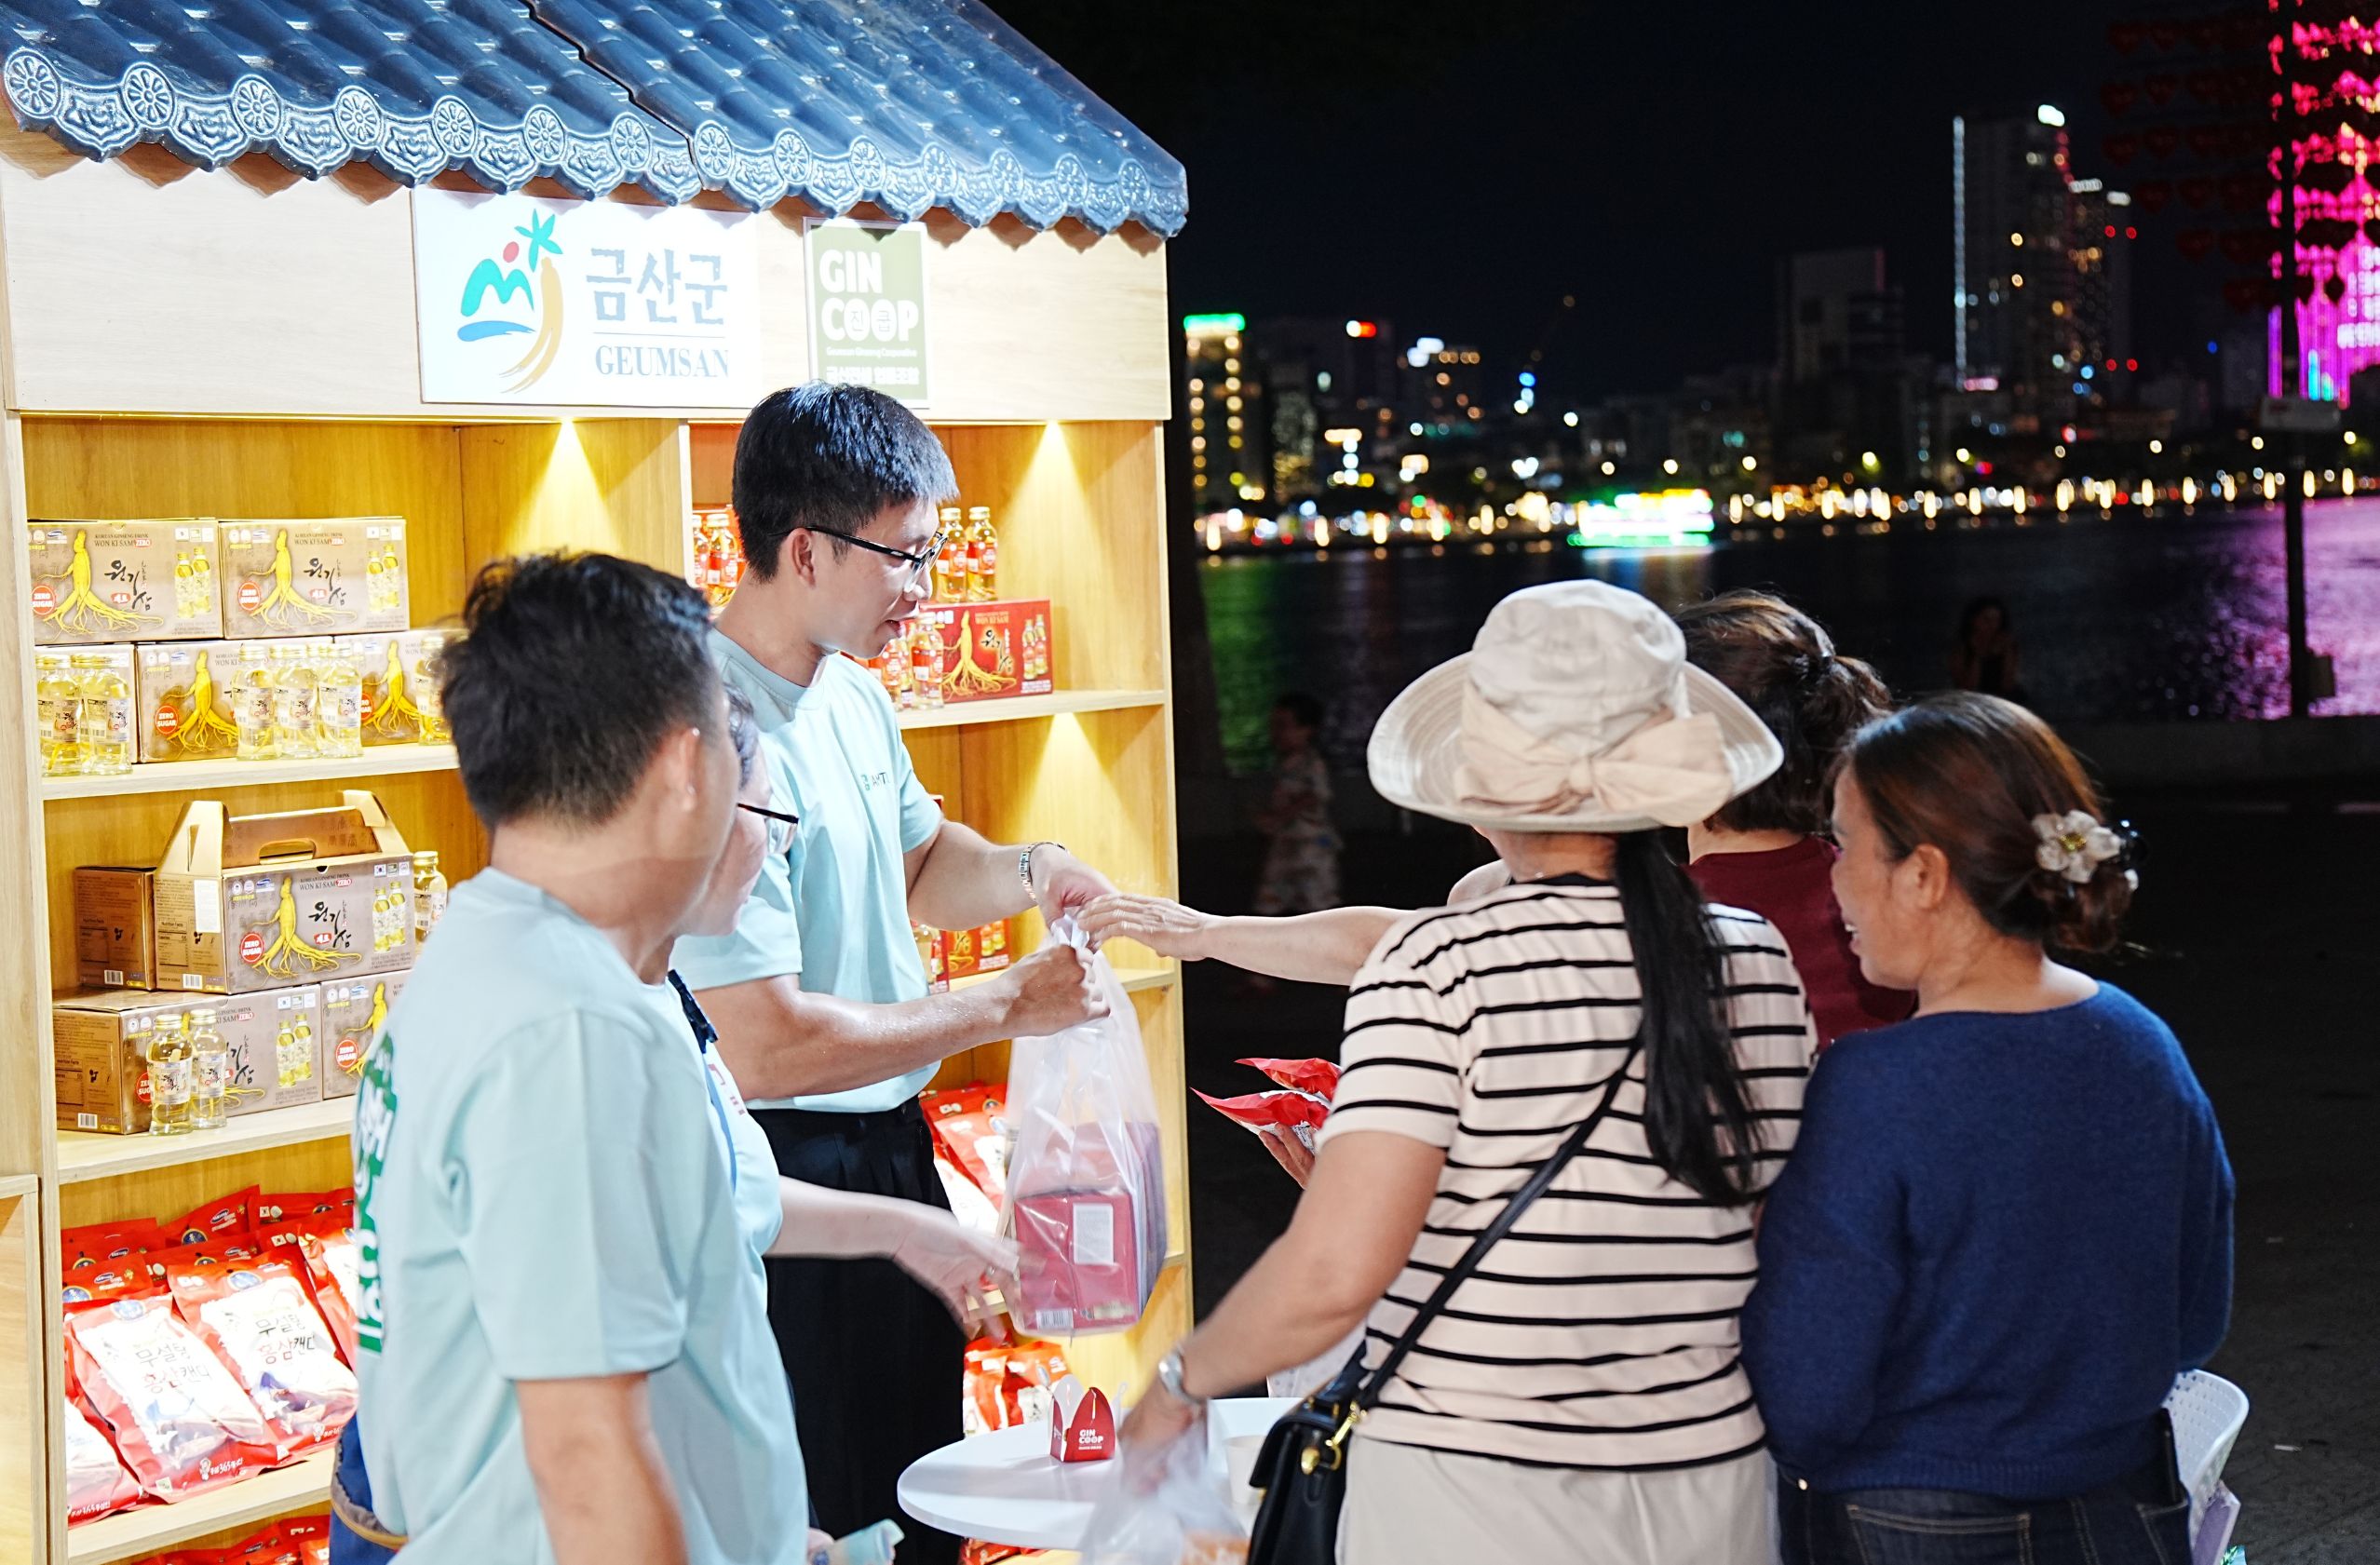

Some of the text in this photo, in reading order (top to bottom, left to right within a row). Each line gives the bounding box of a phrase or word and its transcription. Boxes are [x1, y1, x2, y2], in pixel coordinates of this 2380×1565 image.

[818, 249, 883, 294] GIN
[587, 248, 728, 326] 금산군
[821, 297, 919, 343] COOP
[595, 344, 729, 379] GEUMSAN
[244, 939, 259, 948] ZERO
[242, 947, 262, 956] SUGAR
[223, 1015, 237, 1023] SAM
[238, 1012, 253, 1021] ZERO
[339, 1046, 354, 1054] ZERO
[338, 1054, 358, 1062] SUGAR
[1079, 1428, 1096, 1437] GIN
[1078, 1436, 1104, 1444] COOP
